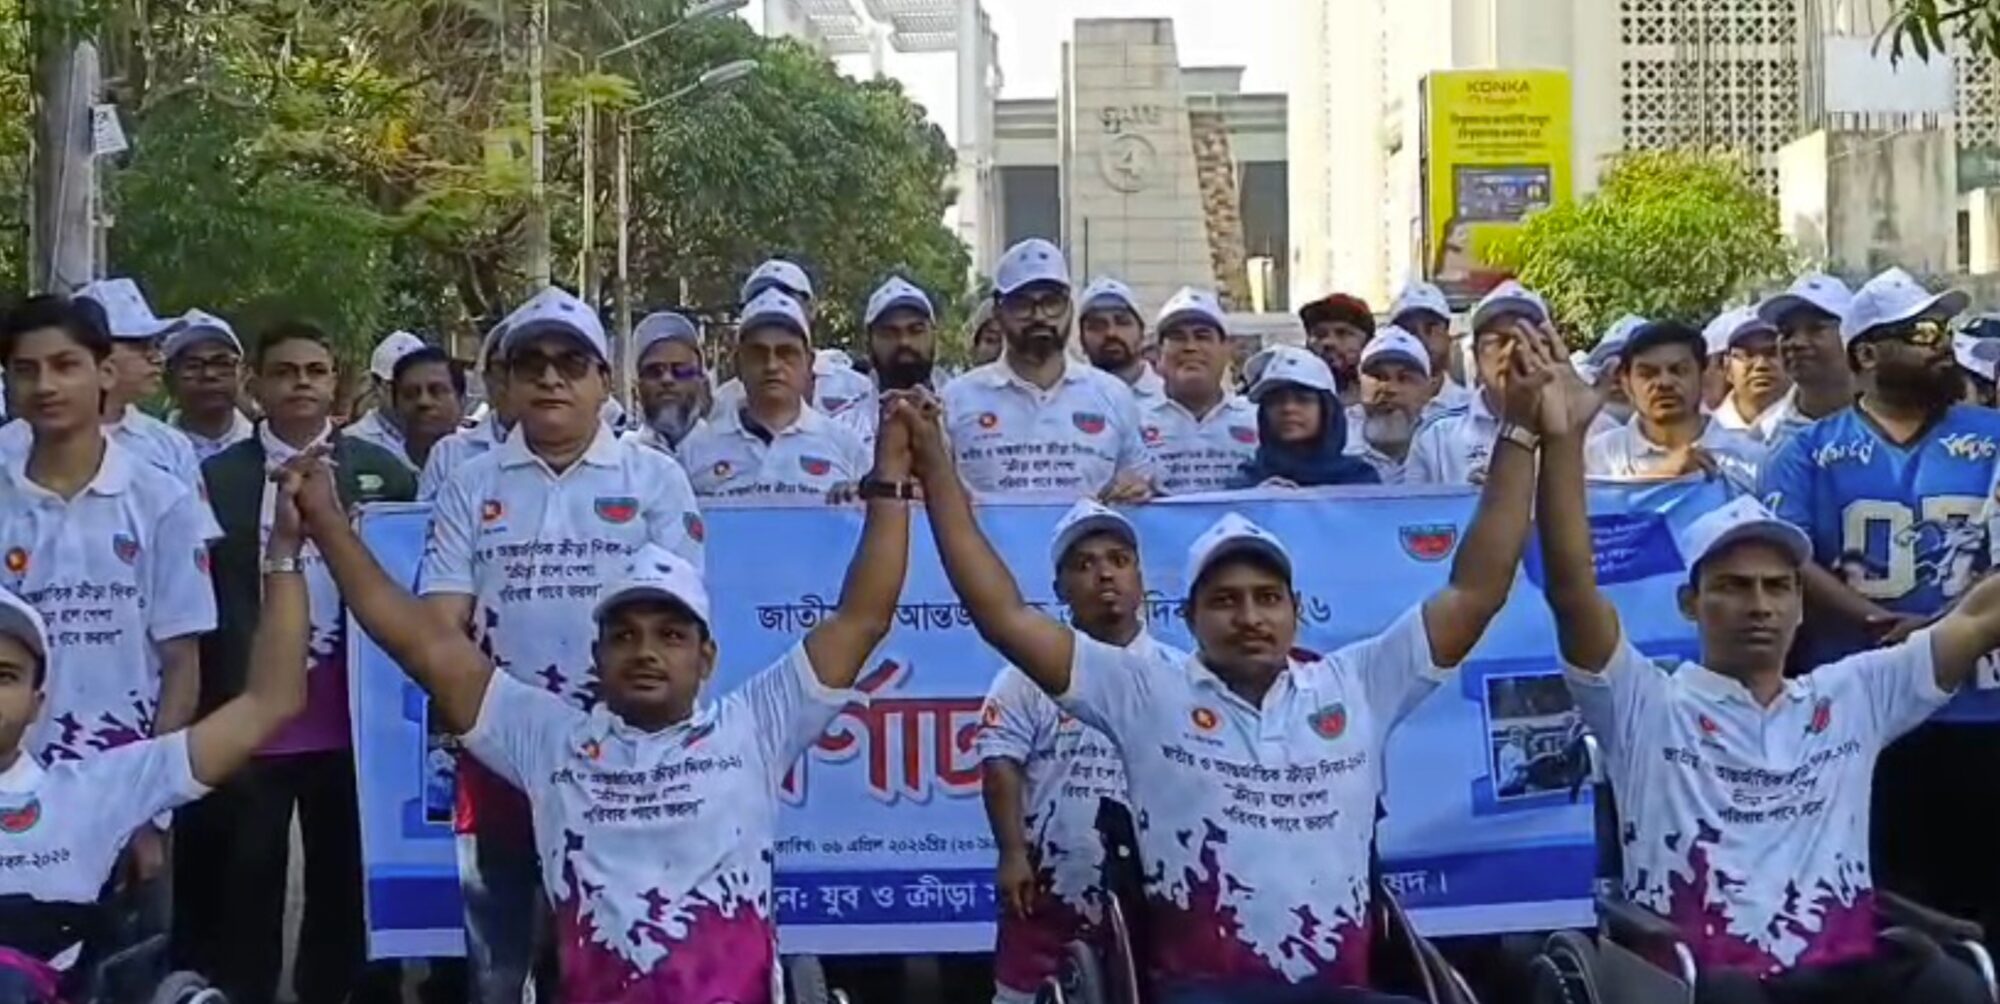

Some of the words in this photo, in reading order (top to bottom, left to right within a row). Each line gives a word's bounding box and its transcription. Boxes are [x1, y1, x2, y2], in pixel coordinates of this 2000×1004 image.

[1466, 80, 1530, 93] KONKA
[755, 594, 840, 633] জাতী
[817, 884, 861, 918] যুব
[871, 886, 896, 908] ও
[903, 874, 978, 912] ক্রীড়া
